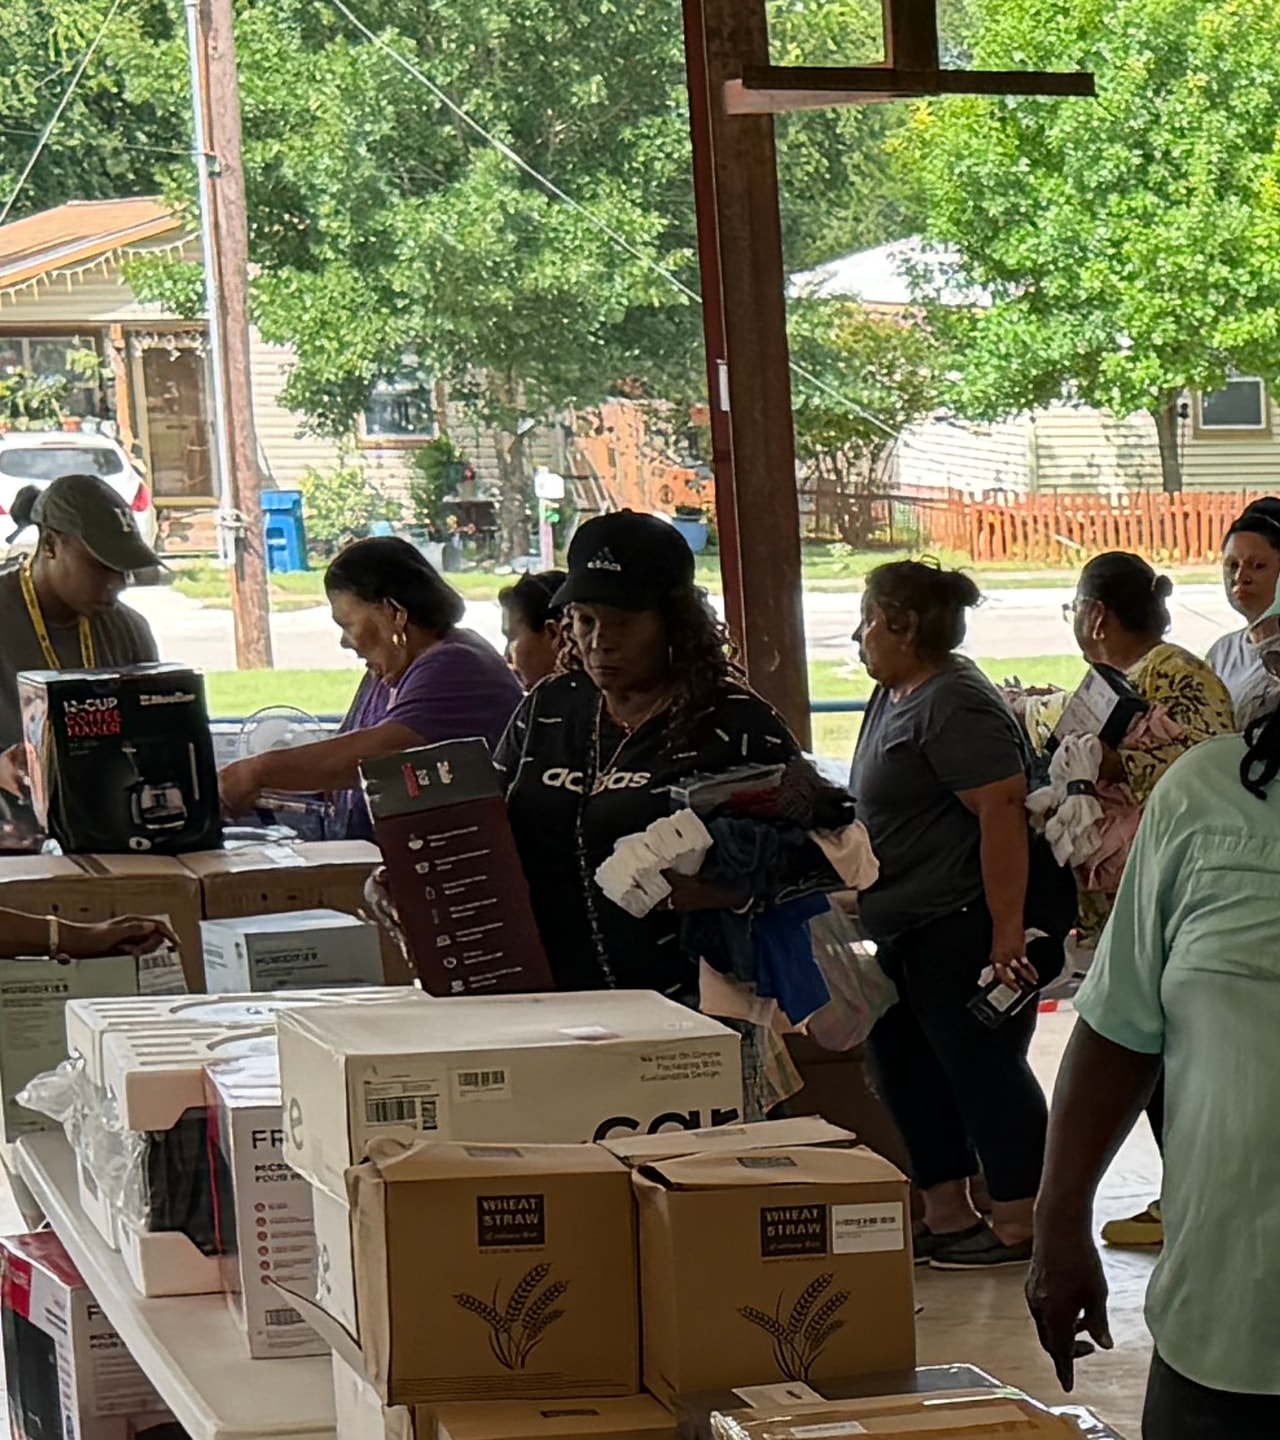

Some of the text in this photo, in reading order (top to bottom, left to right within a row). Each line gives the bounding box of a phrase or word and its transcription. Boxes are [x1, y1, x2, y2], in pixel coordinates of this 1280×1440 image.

[481, 1197, 539, 1211] WHEAT
[482, 1213, 539, 1227] STRAW
[766, 1208, 818, 1222] WHEAT
[767, 1223, 821, 1237] STRAW
